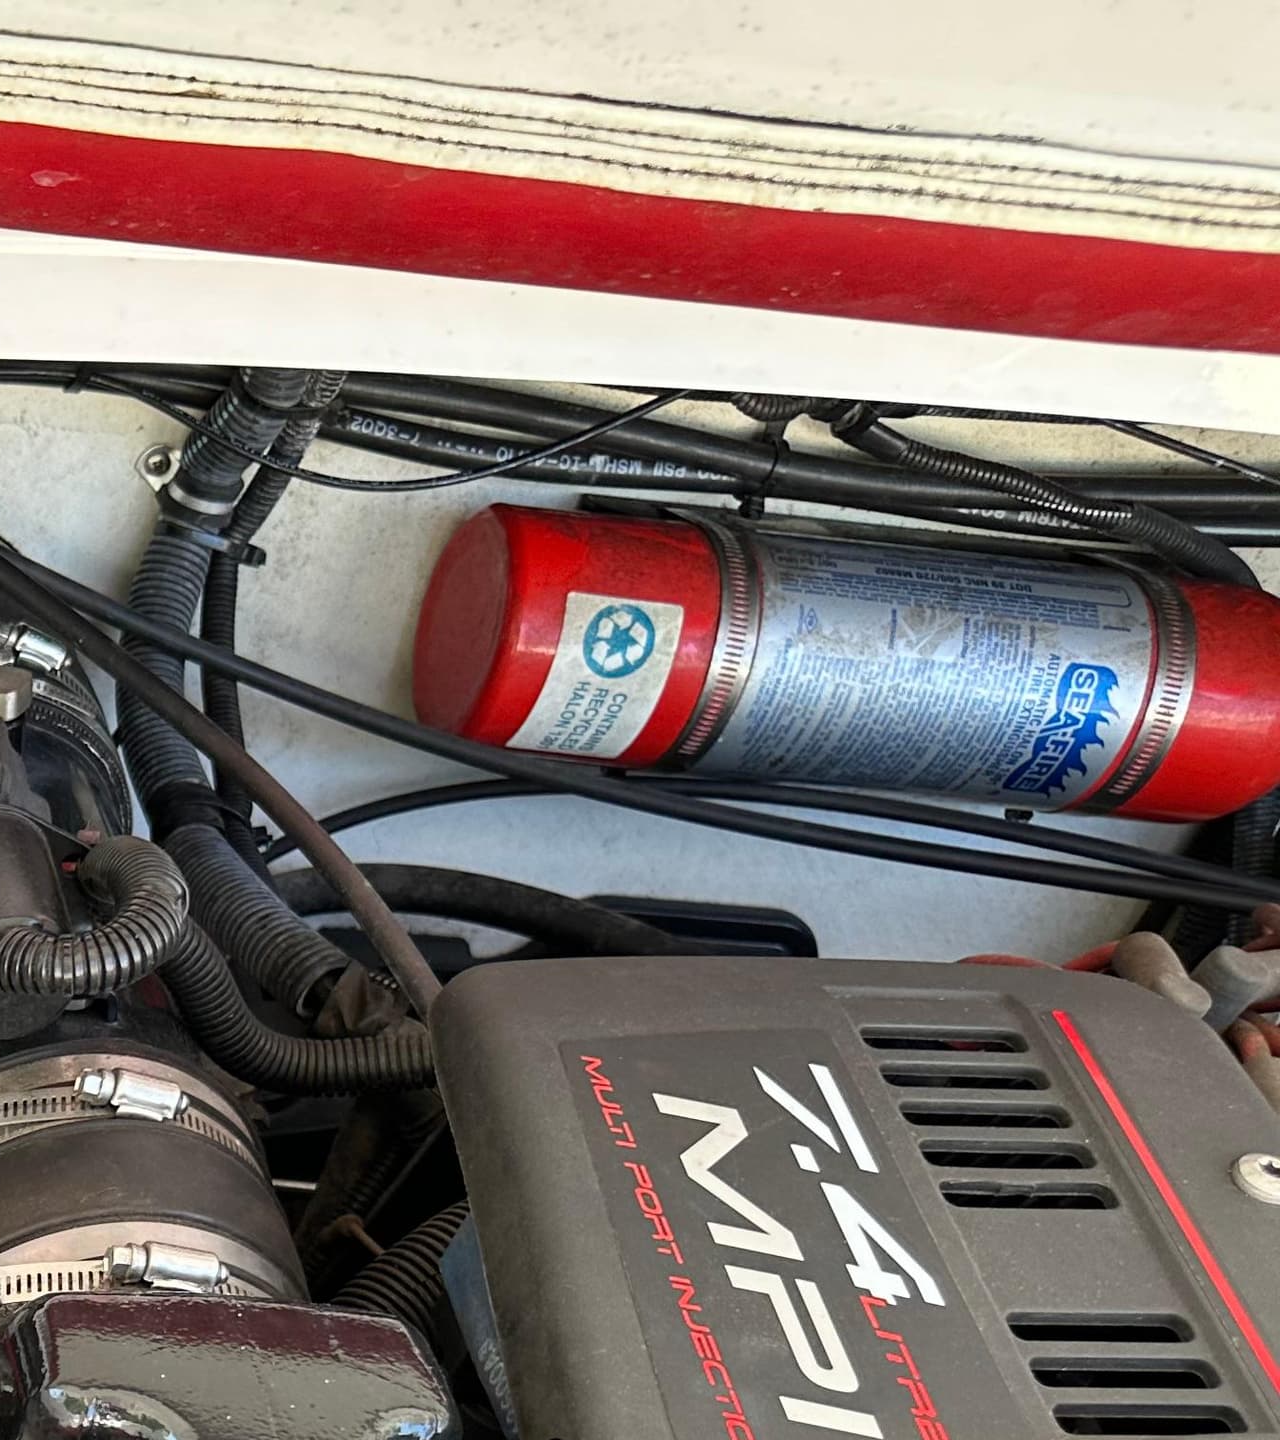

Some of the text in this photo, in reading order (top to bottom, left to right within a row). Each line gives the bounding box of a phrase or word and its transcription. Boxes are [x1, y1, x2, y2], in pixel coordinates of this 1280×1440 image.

[555, 681, 591, 729] HALON
[557, 687, 609, 750] RECYCLED
[1031, 666, 1045, 695] FIRE
[1031, 653, 1062, 729] AUTOMATIC
[579, 1054, 637, 1149] MULTI
[624, 1161, 686, 1265] PORT
[752, 1062, 946, 1307] 7.4
[651, 1092, 884, 1440] MPI
